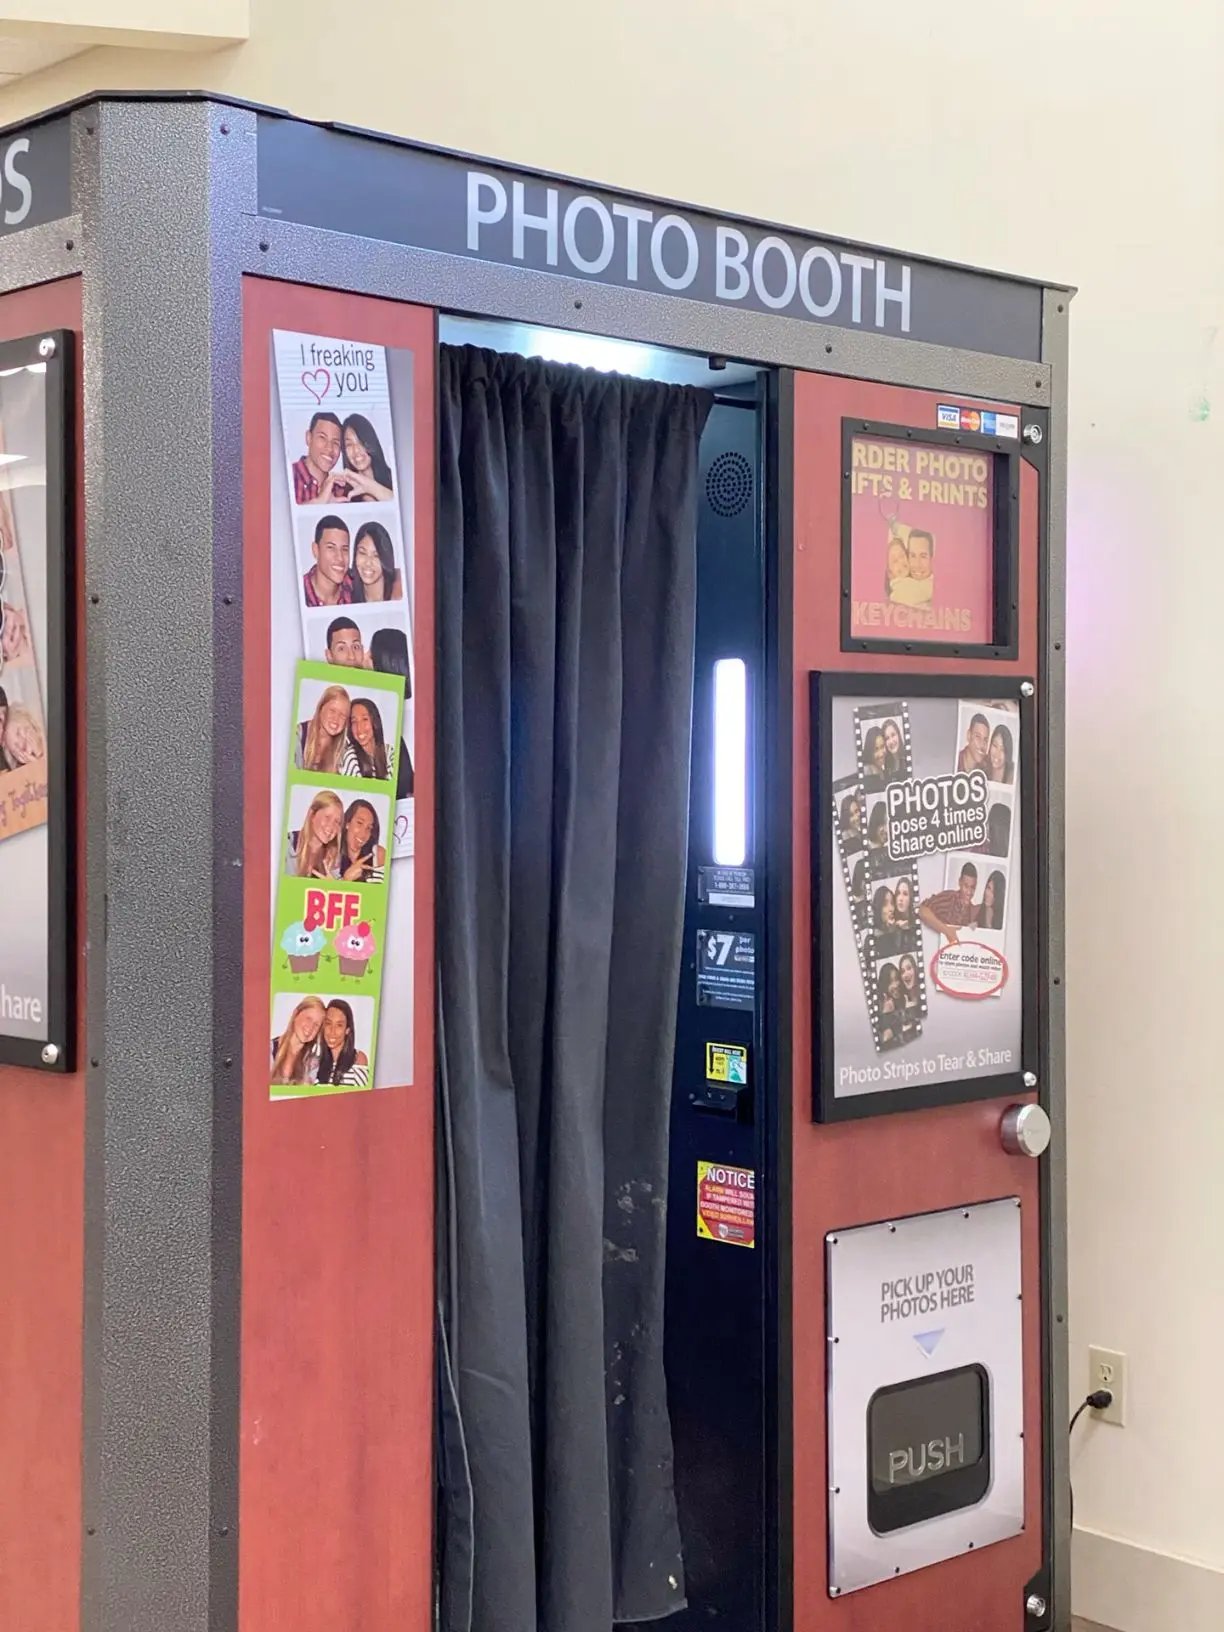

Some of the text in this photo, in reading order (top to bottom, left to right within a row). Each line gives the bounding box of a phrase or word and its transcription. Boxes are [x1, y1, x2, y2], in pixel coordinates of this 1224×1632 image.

[0, 138, 32, 225] S
[466, 171, 911, 332] PHOTO BOOTH
[300, 342, 375, 371] I freaking
[334, 372, 369, 398] you
[941, 412, 957, 422] VISA
[852, 442, 988, 482] RDER PHOTO
[852, 470, 988, 509] IFTS & PRINTS
[853, 601, 972, 632] KEYCHAINS
[889, 776, 985, 816] PHOTOS
[891, 806, 984, 840] pose 4 times
[892, 825, 983, 855] share online
[305, 889, 360, 930] BFF
[707, 934, 735, 966] $7
[940, 953, 960, 961] Enter
[961, 954, 979, 963] code
[0, 983, 42, 1022] hare
[839, 1047, 1012, 1086] Photo Strips to Tear & Share
[706, 1167, 755, 1189] NOTICE
[881, 1264, 973, 1301] PICK UP YOUR
[881, 1284, 974, 1323] PHOTOS HERE
[889, 1432, 964, 1483] PUSH
